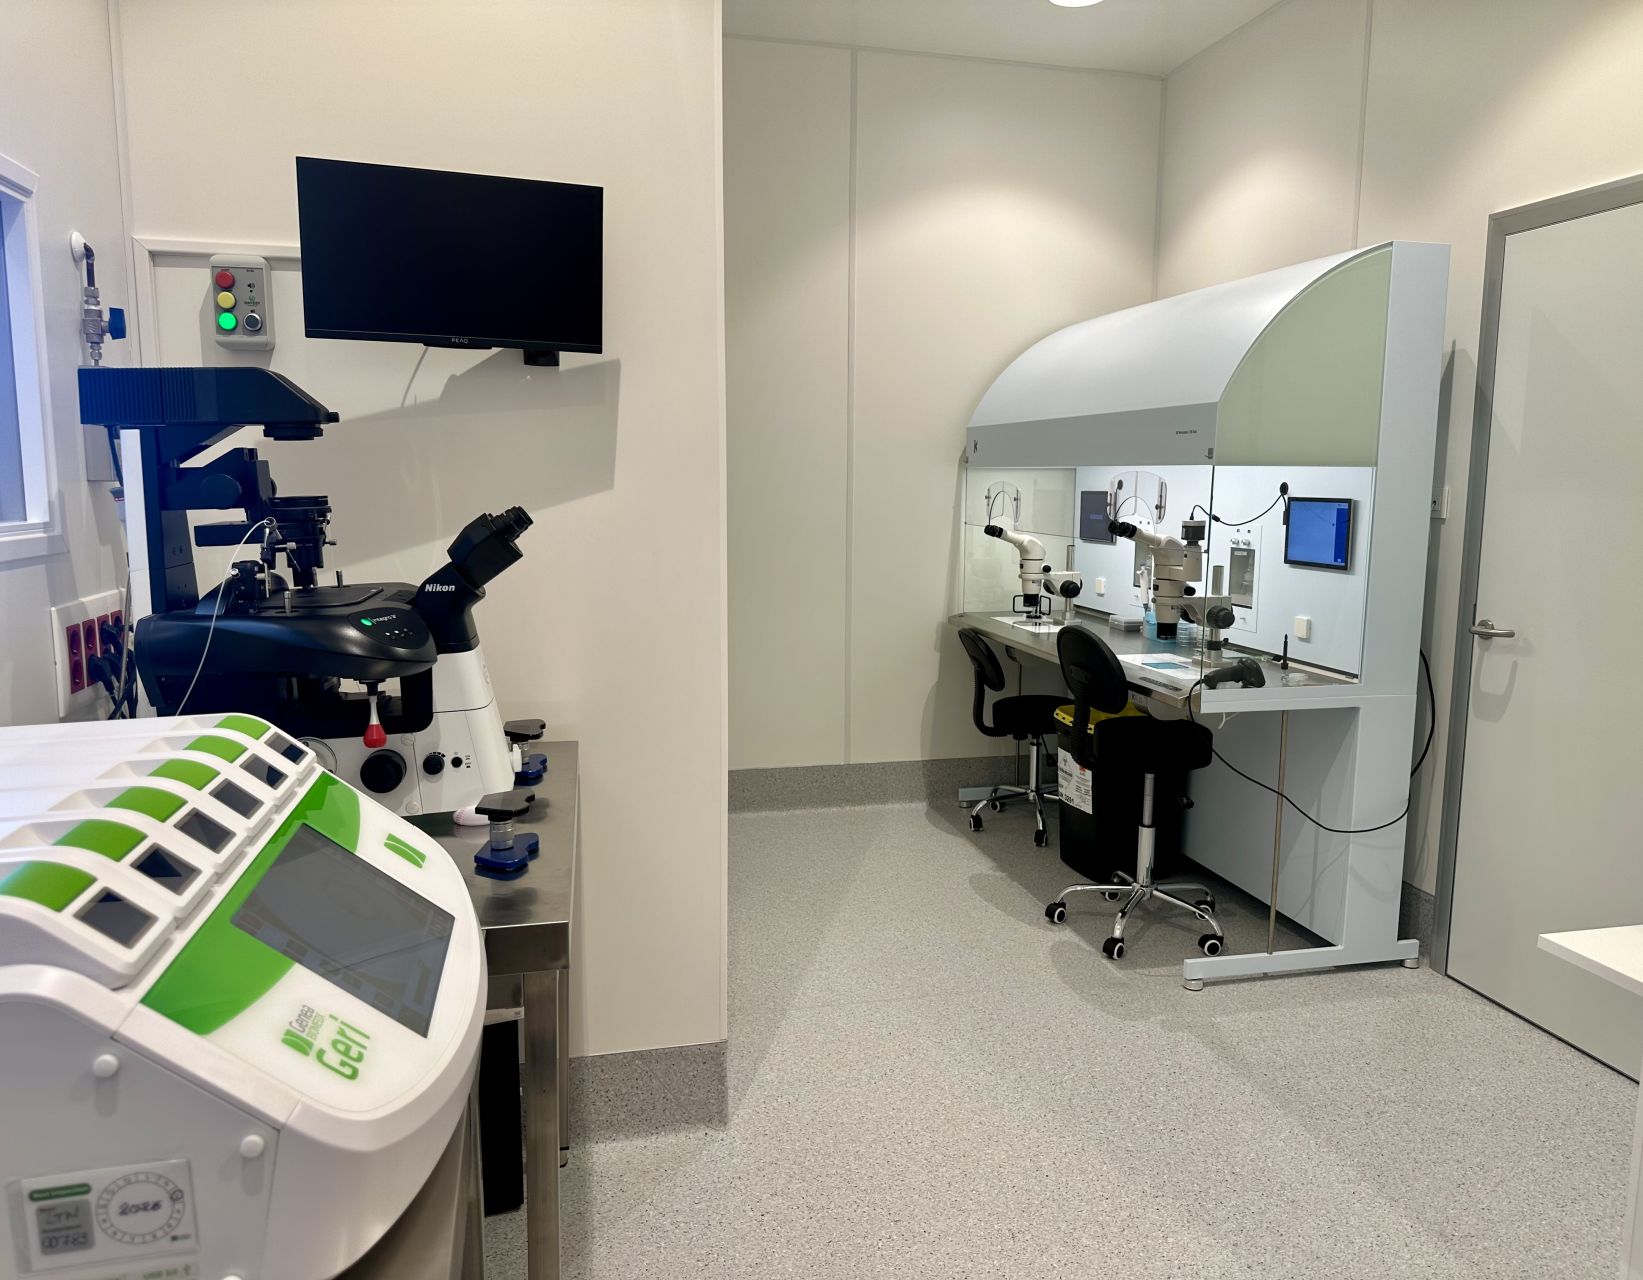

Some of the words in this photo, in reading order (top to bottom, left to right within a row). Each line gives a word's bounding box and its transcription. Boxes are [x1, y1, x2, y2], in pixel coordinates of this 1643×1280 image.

[424, 583, 456, 592] Nikon
[288, 1004, 315, 1034] Genea
[316, 1014, 370, 1081] Geri
